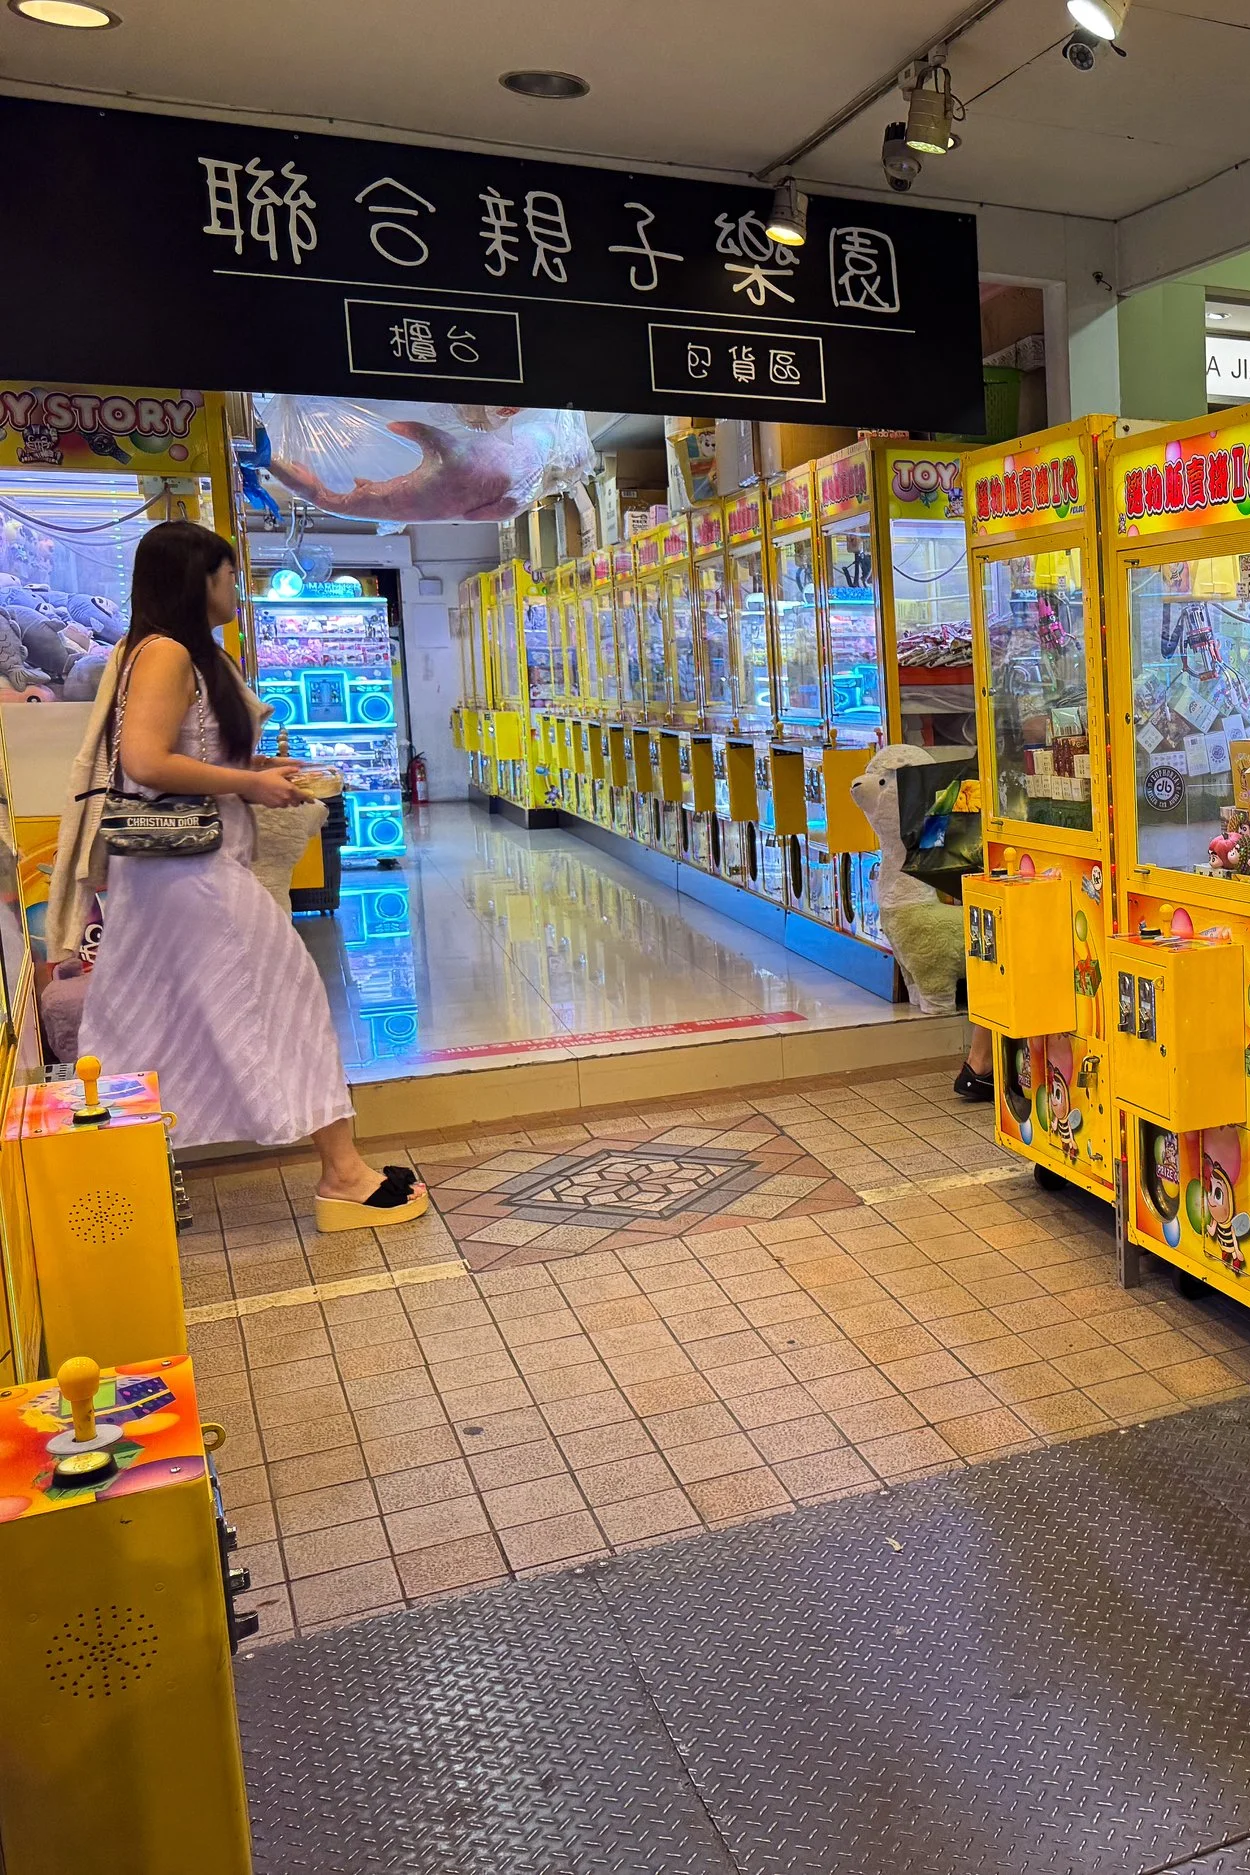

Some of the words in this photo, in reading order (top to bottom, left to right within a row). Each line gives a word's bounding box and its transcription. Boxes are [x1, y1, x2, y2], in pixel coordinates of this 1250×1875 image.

[389, 318, 479, 363] 櫃台
[43, 392, 197, 438] STORY
[893, 460, 960, 495] TOY
[127, 817, 176, 827] CHRISTIAN
[177, 816, 199, 827] DIOR
